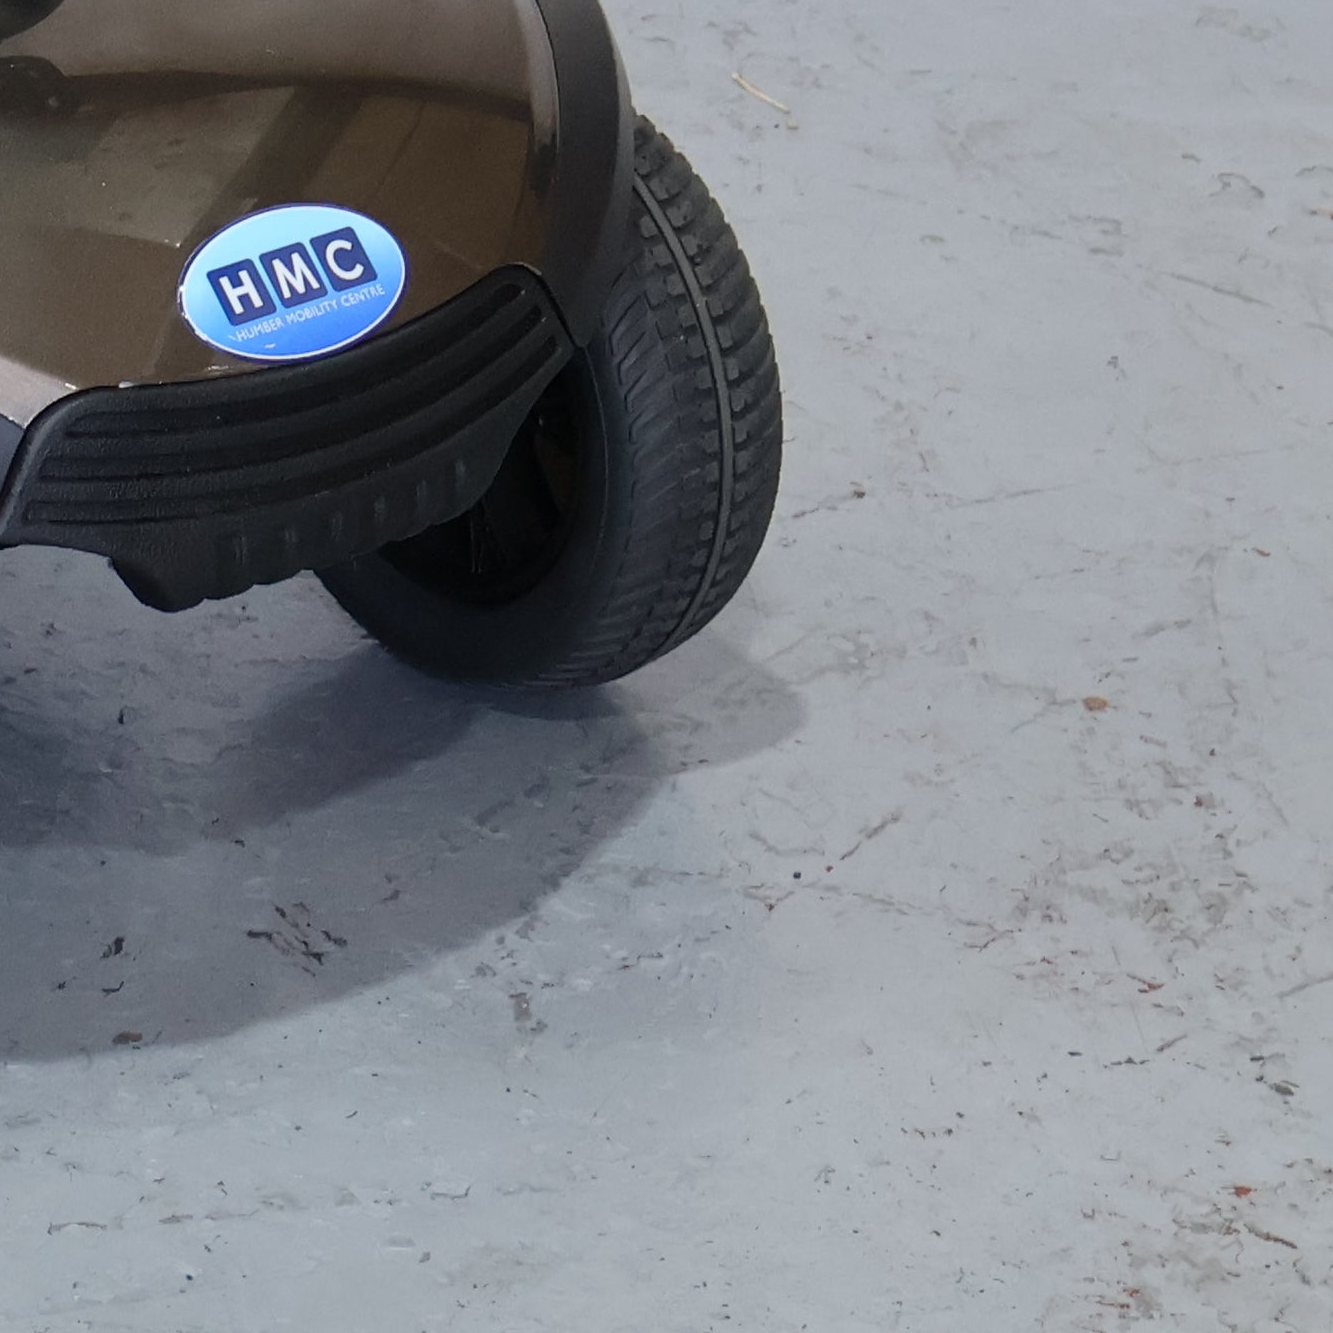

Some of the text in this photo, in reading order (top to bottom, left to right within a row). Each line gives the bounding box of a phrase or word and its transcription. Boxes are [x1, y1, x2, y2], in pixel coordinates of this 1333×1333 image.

[219, 239, 364, 315] HMC
[236, 284, 385, 342] HUMBER MOBILITY CENTRE
